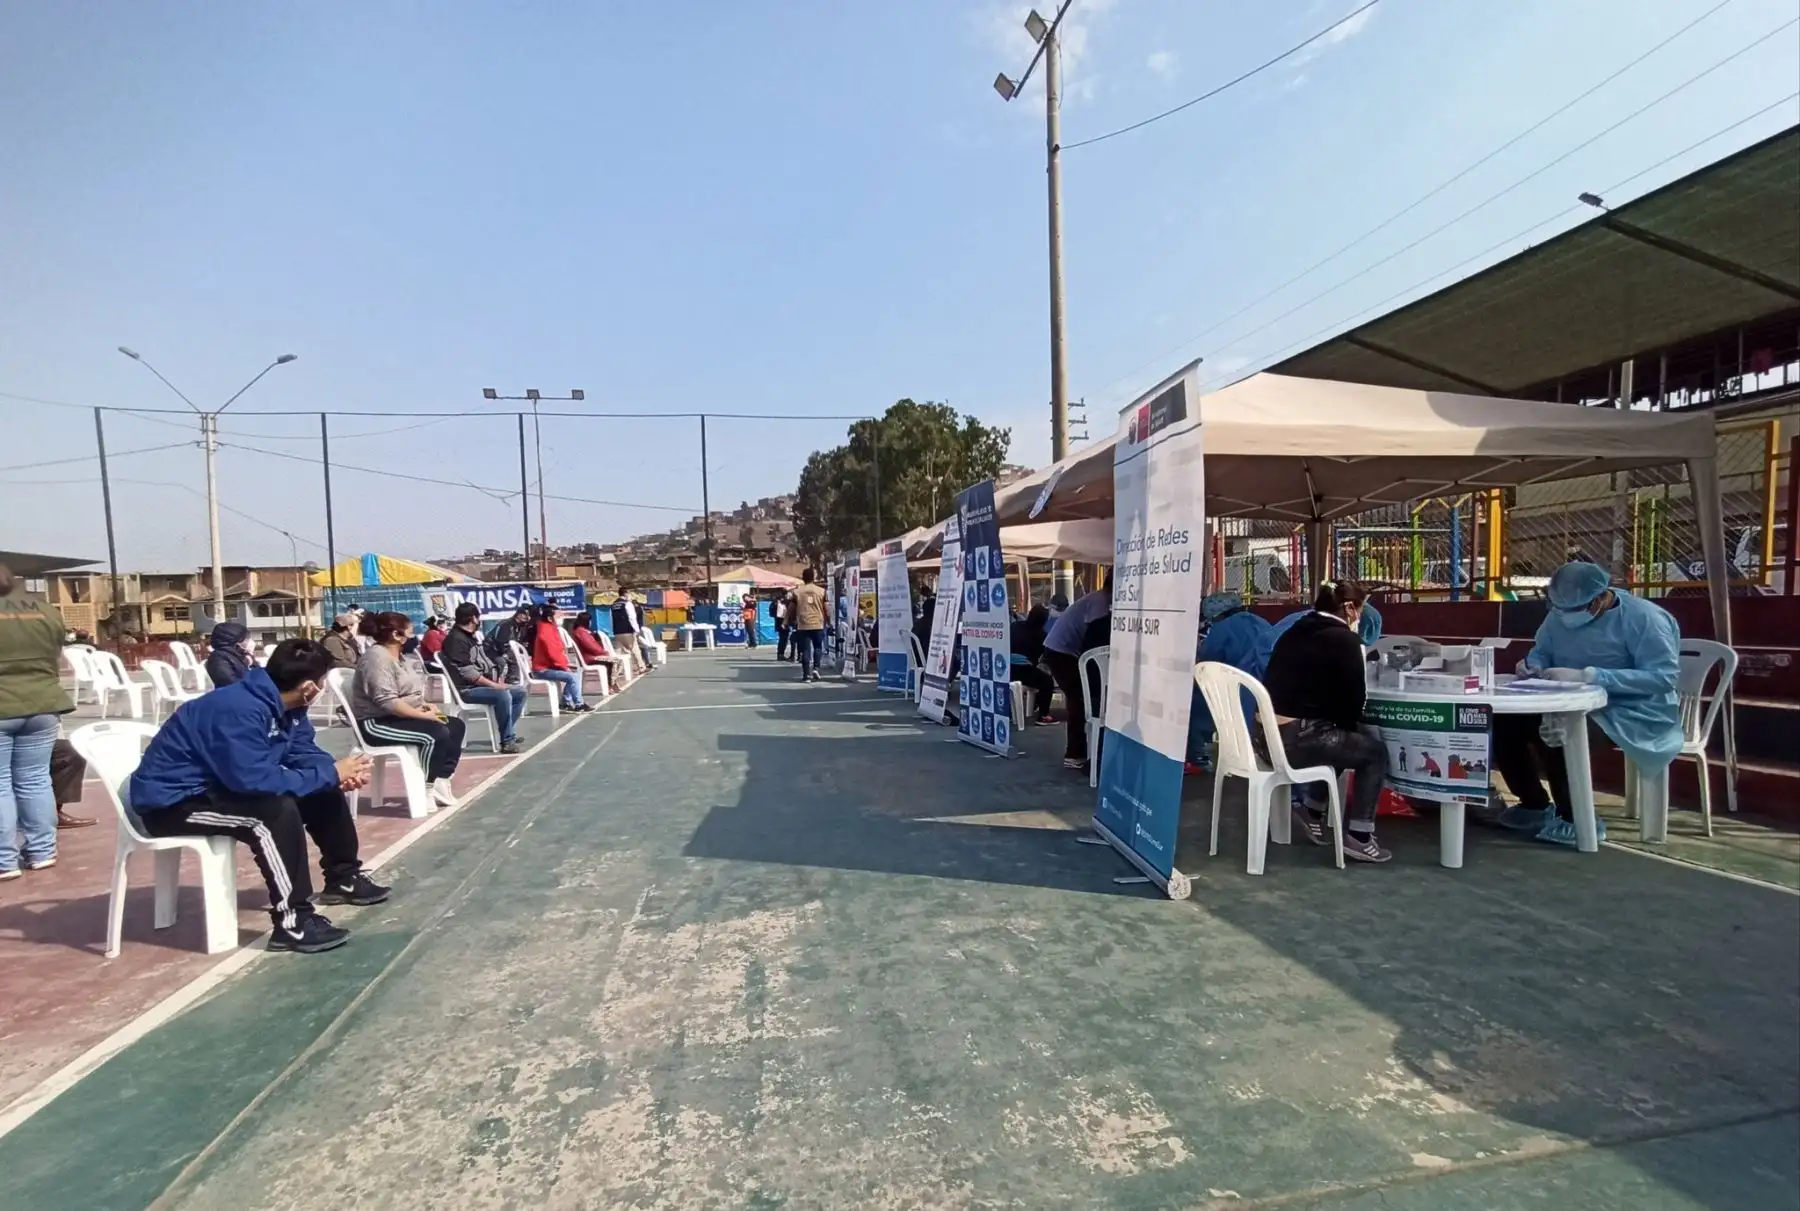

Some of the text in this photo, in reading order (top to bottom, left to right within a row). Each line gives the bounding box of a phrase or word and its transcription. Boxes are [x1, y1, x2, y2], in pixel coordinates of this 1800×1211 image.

[1146, 532, 1156, 550] de
[1158, 524, 1189, 548] Redes
[1149, 556, 1160, 575] de
[454, 589, 533, 608] MINSA
[1128, 618, 1143, 633] LIMA
[1144, 619, 1160, 636] SUR
[1379, 712, 1387, 720] de
[1388, 712, 1395, 720] la
[1396, 713, 1445, 724] COVID-19
[1459, 713, 1474, 725] NO
